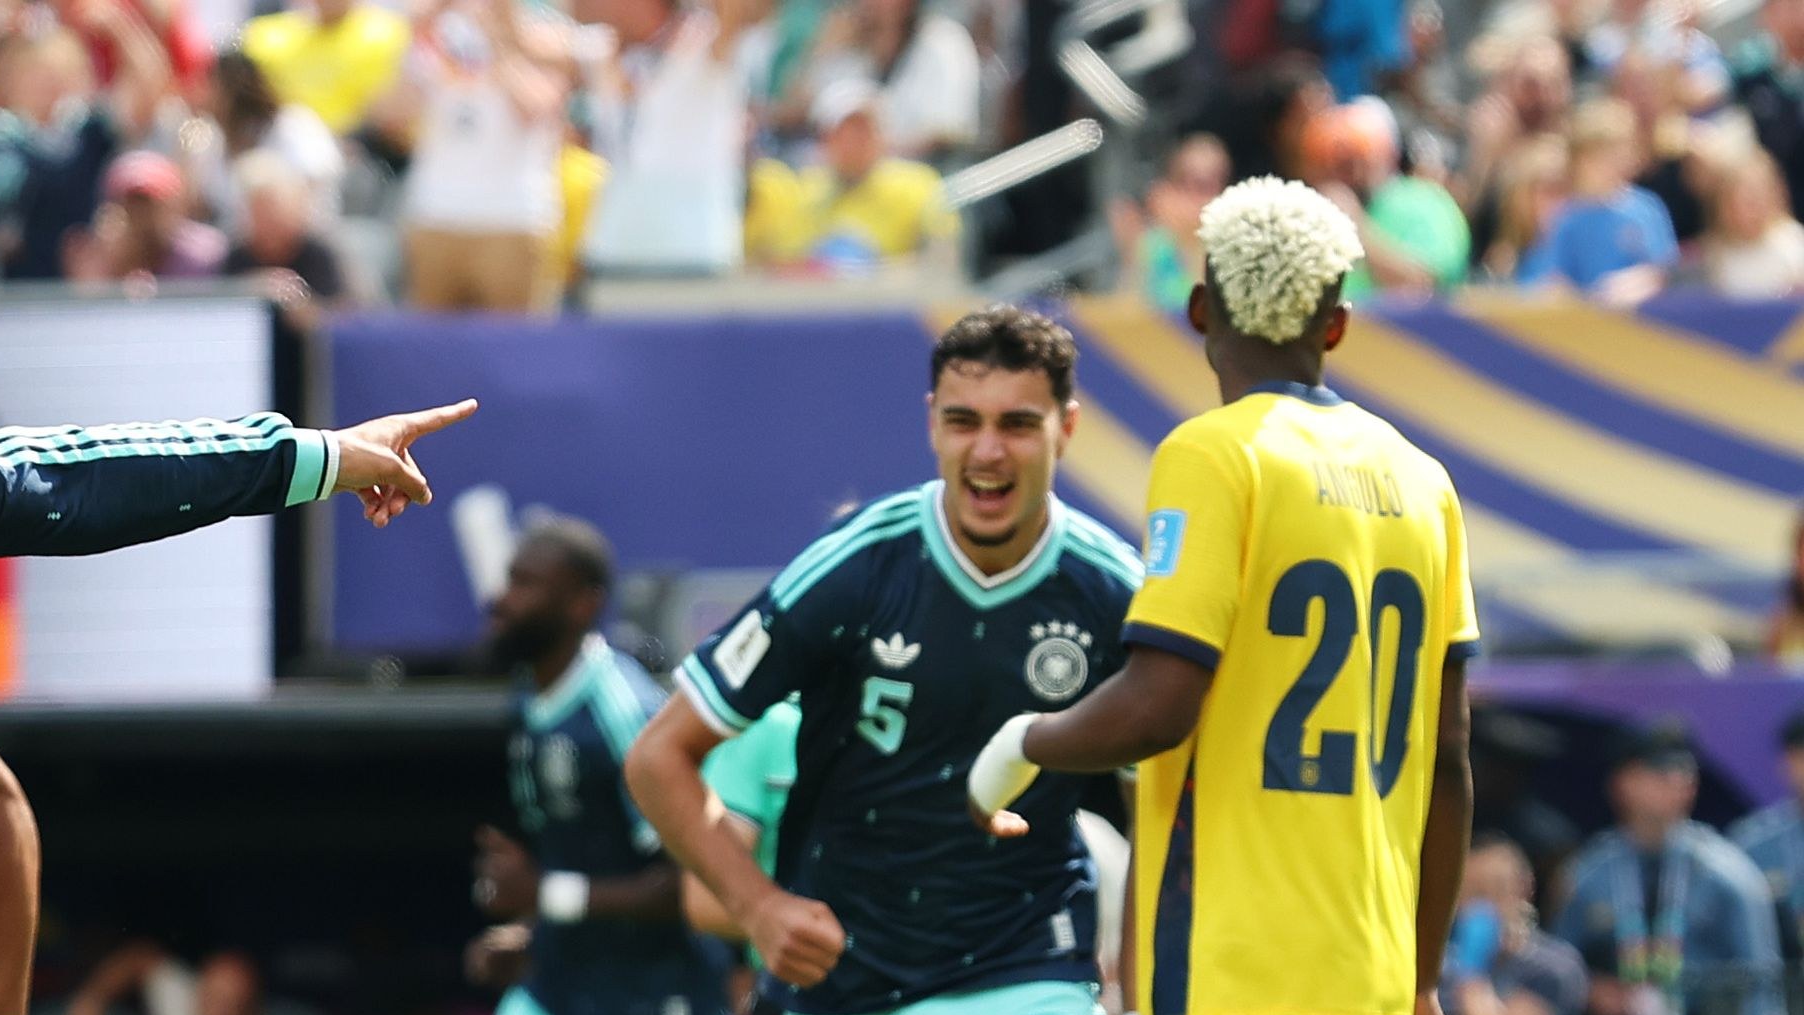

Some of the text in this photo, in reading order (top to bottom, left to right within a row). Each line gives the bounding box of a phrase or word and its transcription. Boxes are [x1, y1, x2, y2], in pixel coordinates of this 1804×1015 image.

[1312, 461, 1404, 518] ANGULO
[856, 676, 914, 755] 5
[1261, 558, 1426, 800] 20
